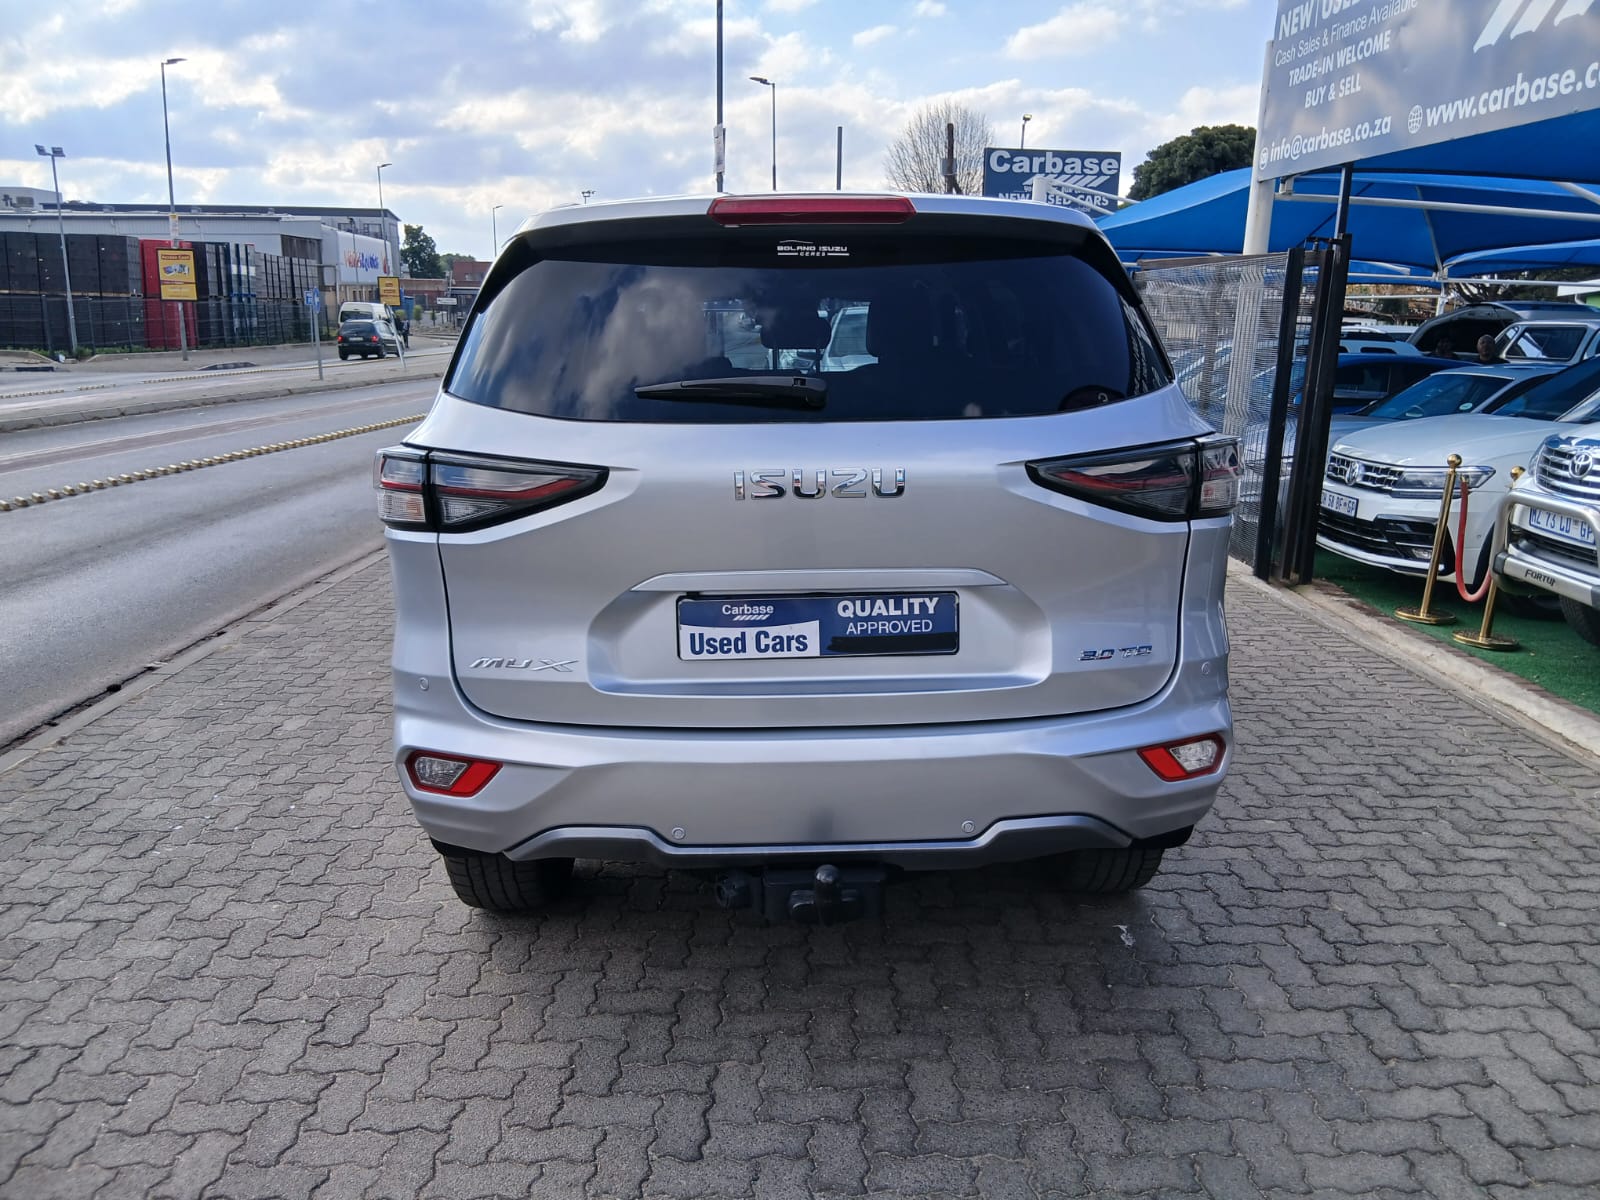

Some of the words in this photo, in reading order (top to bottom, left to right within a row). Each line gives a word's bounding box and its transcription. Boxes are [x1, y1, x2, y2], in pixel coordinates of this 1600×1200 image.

[1278, 0, 1314, 41] NEW
[1275, 47, 1296, 67] Cash
[1297, 38, 1320, 57] Sales
[1322, 28, 1329, 47] &
[1330, 15, 1368, 44] Finance
[1288, 53, 1335, 88] TRADE-IN
[1336, 30, 1392, 68] WELCOME
[1304, 85, 1327, 109] BUY
[1327, 82, 1336, 101] &
[1338, 72, 1362, 98] SELL
[1425, 62, 1600, 129] www.carbase.c
[1269, 115, 1392, 163] info@carbase.co.za
[989, 150, 1120, 175] Carbase
[1044, 193, 1072, 206] SED
[734, 467, 906, 501] ISUZU
[722, 604, 774, 615] Carbase
[837, 597, 939, 618] QUALITY
[689, 631, 746, 655] Used
[755, 630, 808, 654] Cars
[846, 619, 933, 635] APPROVED
